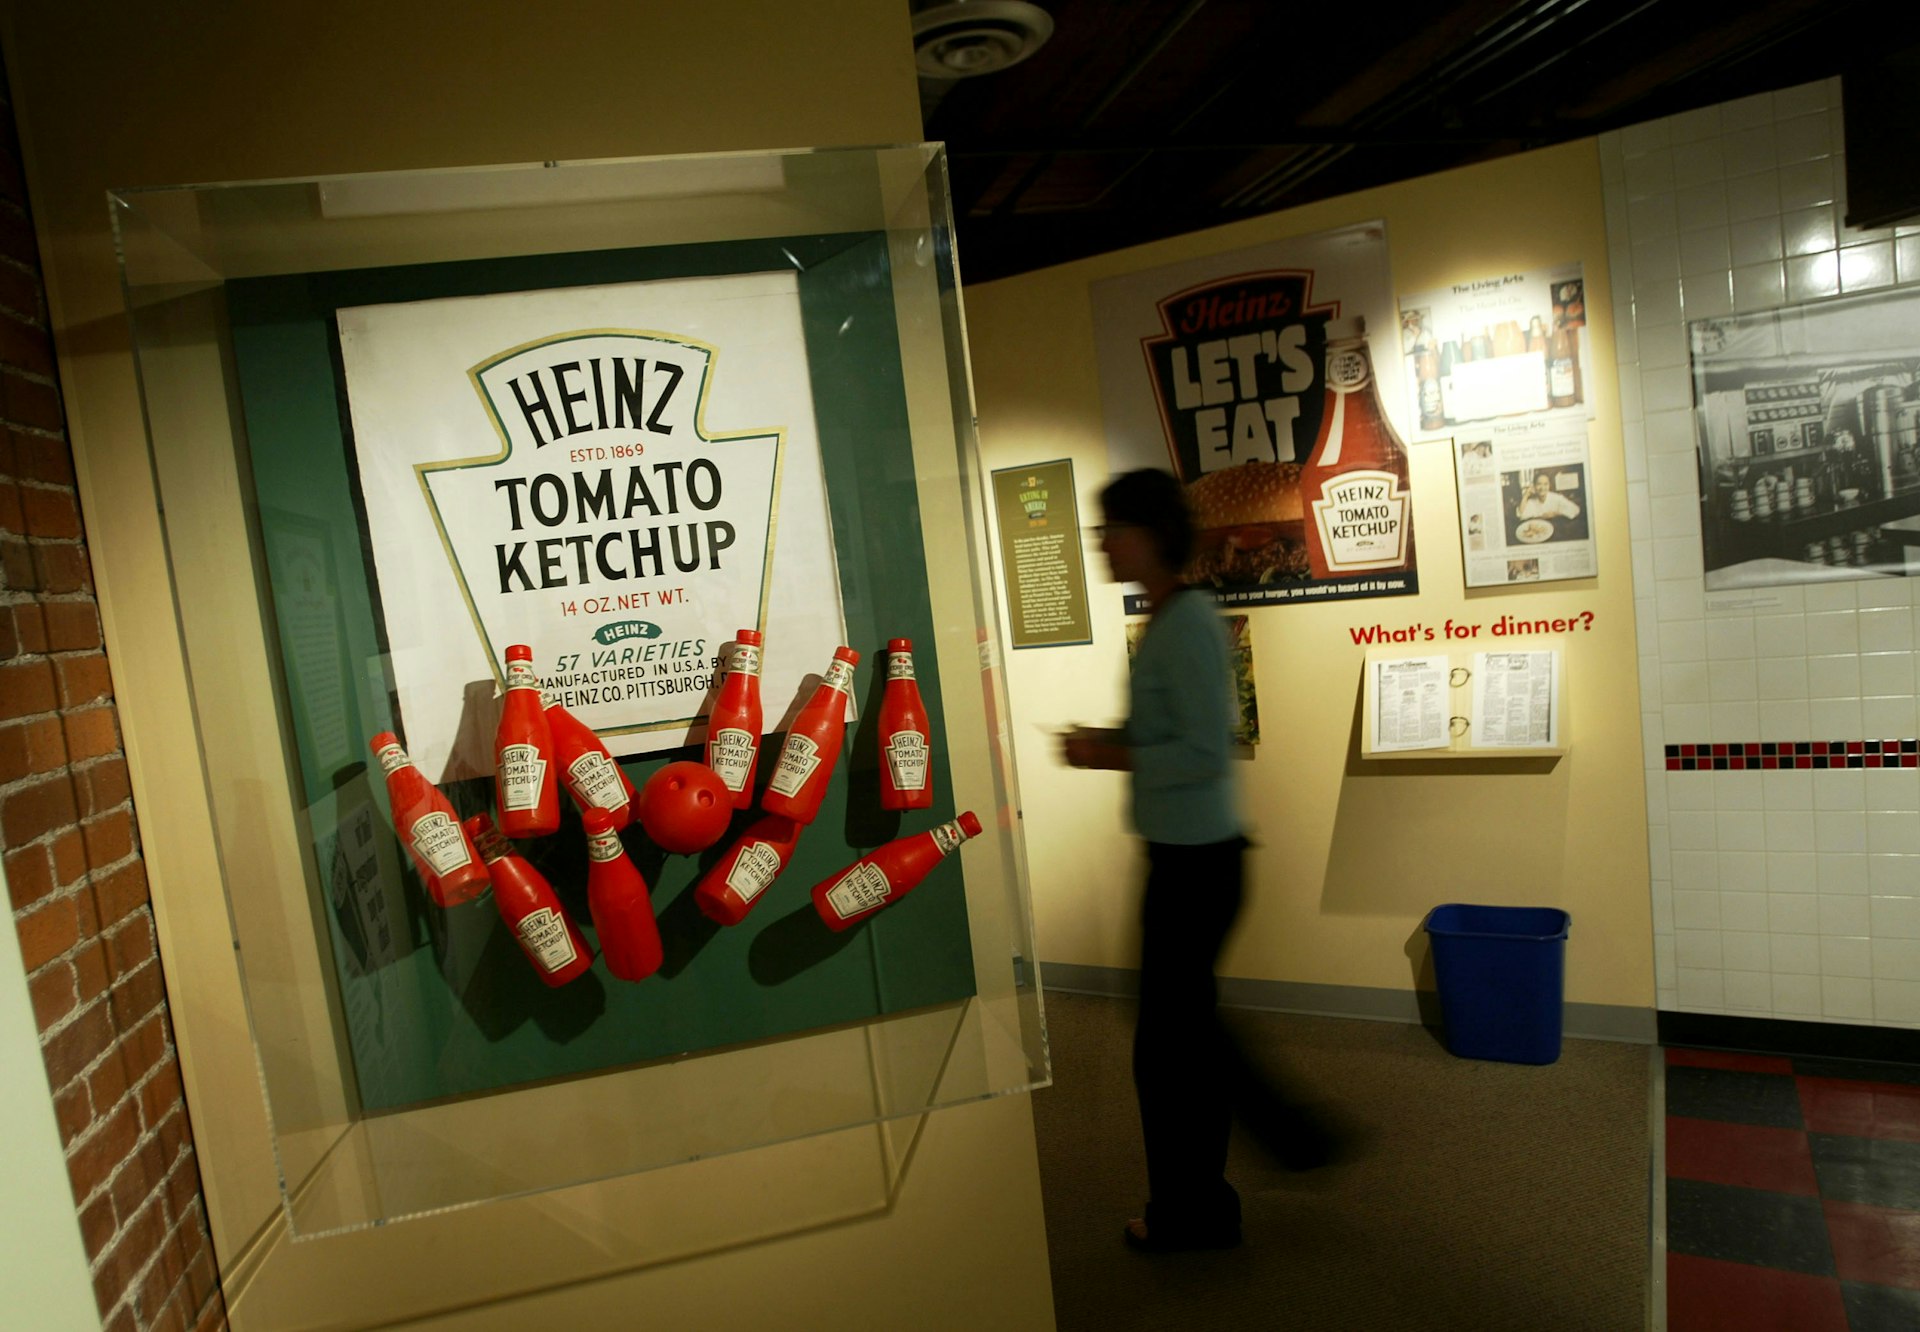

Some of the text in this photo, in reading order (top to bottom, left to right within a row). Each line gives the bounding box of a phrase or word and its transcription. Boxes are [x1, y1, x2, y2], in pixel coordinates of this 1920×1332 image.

[1181, 290, 1291, 333] Heinz
[1171, 324, 1314, 410] LET'S
[506, 357, 684, 449] HEINZ
[1195, 395, 1300, 473] EAT
[611, 443, 644, 459] 1869
[494, 458, 722, 531] TOMATO
[1337, 486, 1384, 504] HEINZ
[1338, 505, 1389, 522] TOMATO
[1332, 520, 1398, 539] KETCHUP
[494, 520, 736, 594] KETCHUP
[560, 600, 577, 617] 14
[657, 588, 689, 606] WT.
[603, 623, 648, 641] HEINZ
[1349, 611, 1595, 645] What's for dinner?
[555, 653, 581, 672] 57
[591, 639, 706, 668] VARIETIES
[653, 663, 668, 676] IN
[673, 658, 708, 673] U.S.A.
[711, 656, 727, 668] BY
[553, 688, 599, 708] HEINZ
[602, 686, 625, 703] CO.
[722, 734, 748, 748] HEINZ
[896, 736, 919, 748] HEINZ
[716, 758, 748, 768] KETCHUP
[718, 747, 749, 759] TOMATO
[784, 751, 808, 766] OMATO
[894, 750, 923, 758] TOMATO
[575, 757, 598, 777] HEINZ
[893, 759, 925, 768] KETCHUP
[580, 766, 610, 788] TOMATO
[418, 817, 443, 836] HEINZ
[423, 827, 455, 846] TOMATO
[426, 835, 460, 858] KETCHUP
[864, 870, 885, 892] HEINZ
